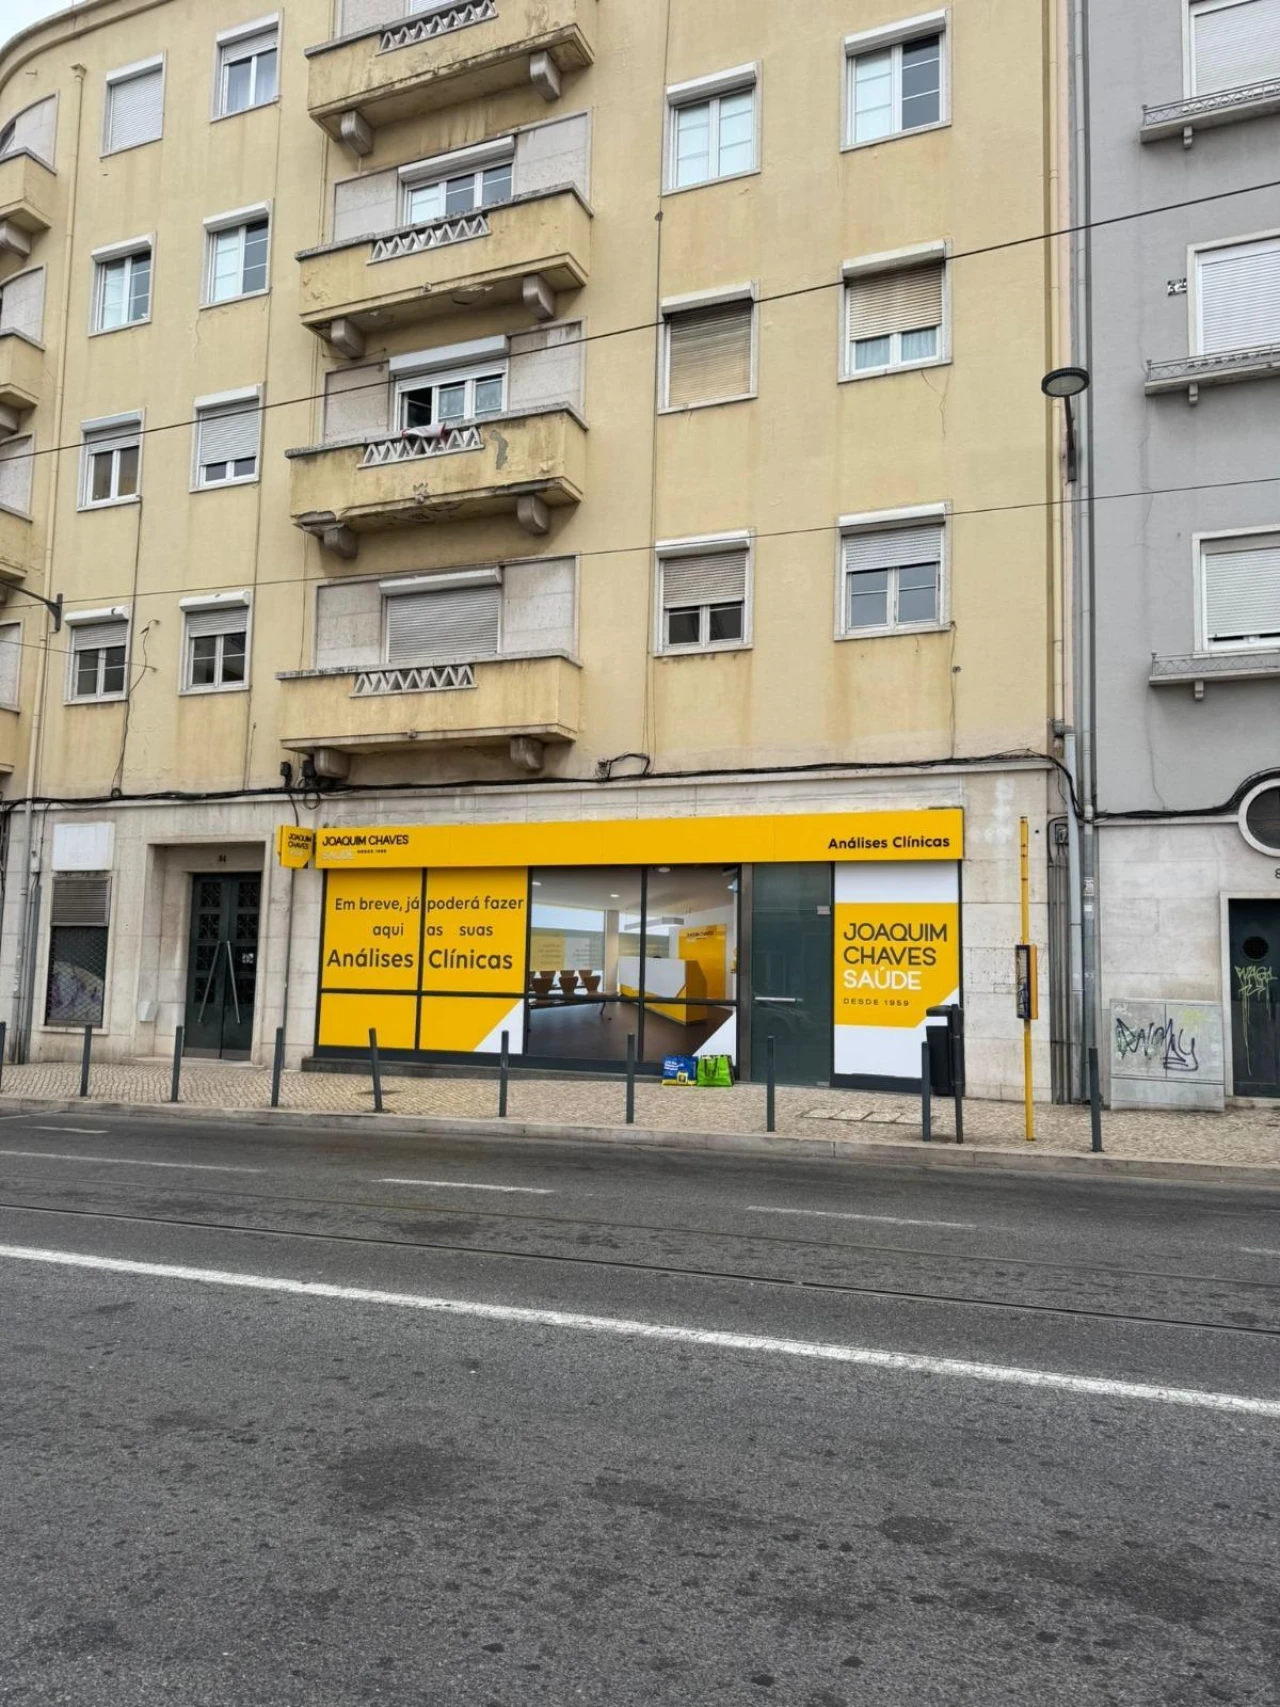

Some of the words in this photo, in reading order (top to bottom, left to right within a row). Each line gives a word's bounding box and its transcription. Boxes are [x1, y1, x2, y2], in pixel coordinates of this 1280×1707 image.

[322, 836, 366, 847] JOAQUIM
[368, 834, 409, 846] CHAVES
[828, 836, 888, 849] Análises
[892, 835, 950, 848] Clínicas
[335, 898, 355, 911] Em
[359, 897, 402, 912] breve,
[405, 897, 420, 913] já
[427, 896, 480, 913] poderá
[484, 896, 524, 910] fazer
[372, 923, 404, 939] aqui
[426, 925, 443, 936] as
[459, 924, 493, 936] suas
[843, 923, 947, 942] JOAQUIM
[327, 948, 414, 968] Análises
[428, 948, 513, 969] Clínicas
[843, 946, 937, 966] CHAVES
[843, 966, 922, 990] SAÚDE
[843, 998, 879, 1006] DESDE
